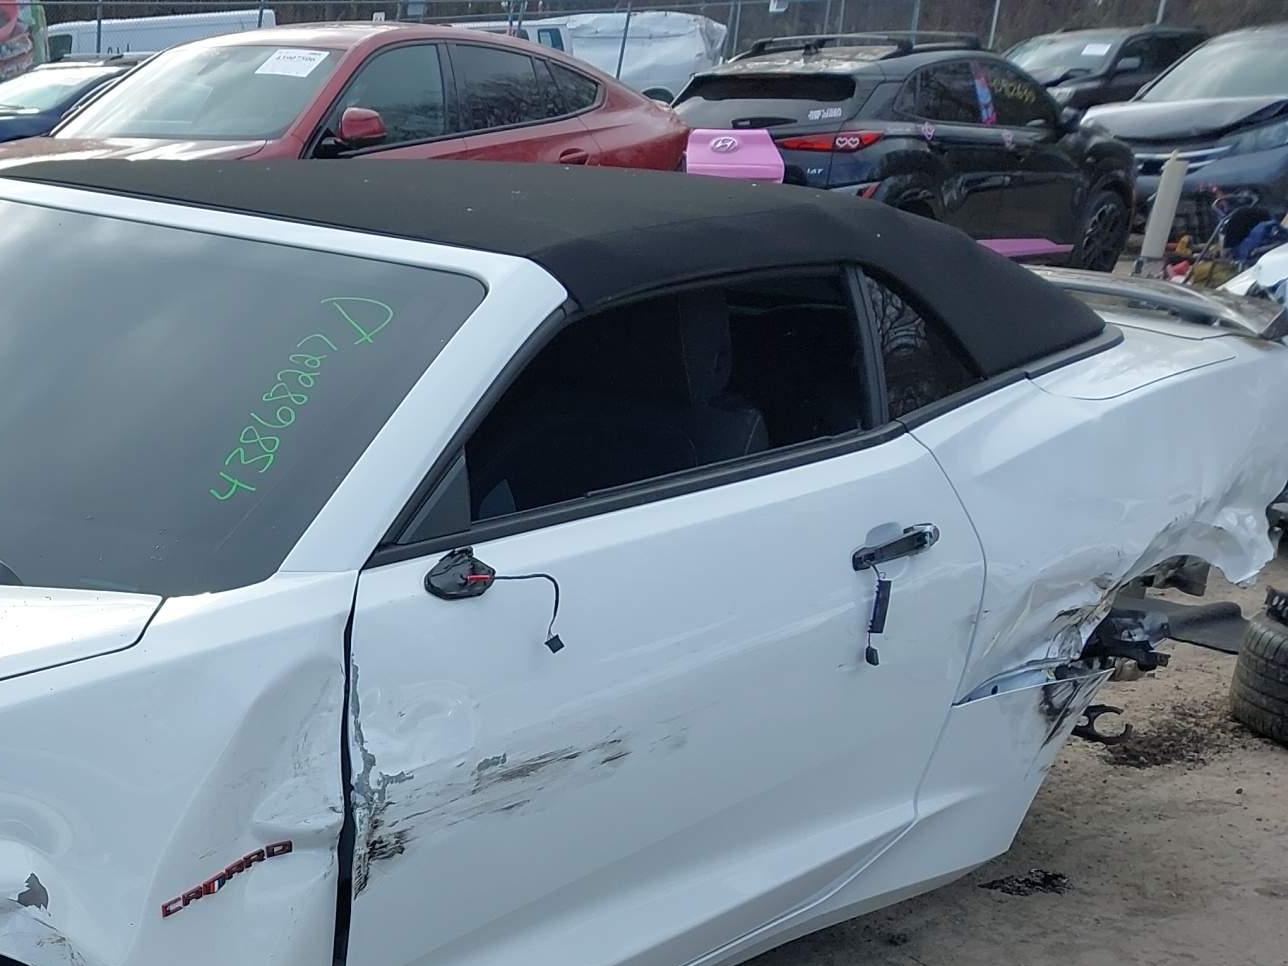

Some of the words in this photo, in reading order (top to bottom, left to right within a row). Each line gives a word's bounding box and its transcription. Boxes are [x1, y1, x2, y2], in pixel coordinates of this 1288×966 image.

[209, 333, 338, 500] 43868227
[320, 296, 394, 345] D
[161, 840, 293, 918] CAMARO
